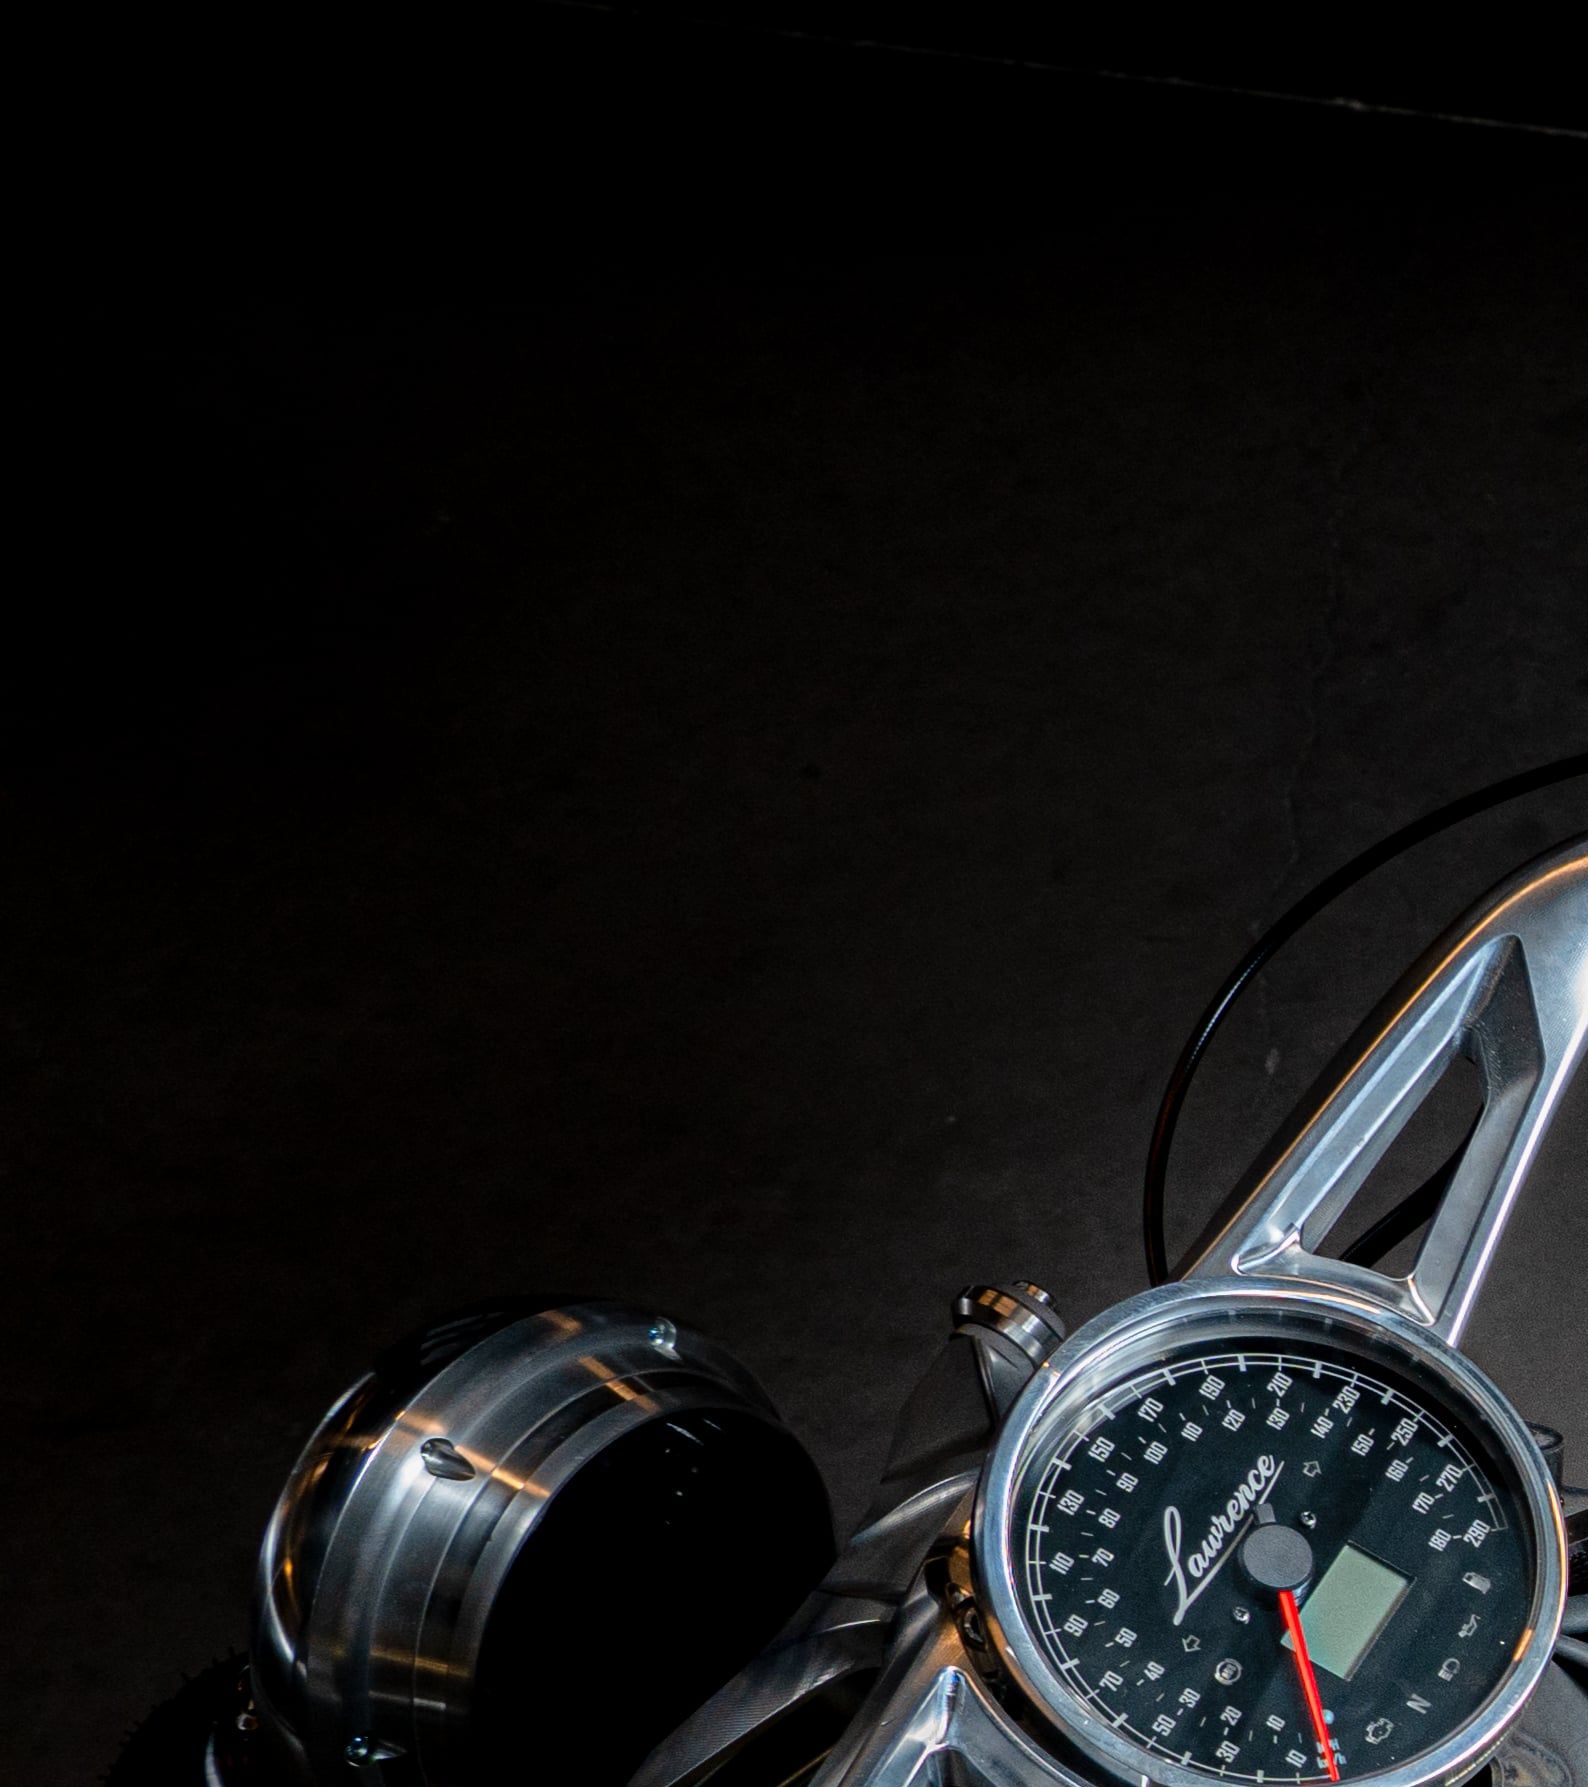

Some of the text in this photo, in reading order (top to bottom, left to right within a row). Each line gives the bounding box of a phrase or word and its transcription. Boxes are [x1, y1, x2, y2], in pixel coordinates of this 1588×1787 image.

[1199, 1375, 1226, 1400] 190
[1266, 1372, 1293, 1397] 210
[1137, 1397, 1164, 1422] 170
[1333, 1385, 1361, 1414] 230
[1222, 1409, 1246, 1432] 120
[1266, 1407, 1290, 1430] 130
[1310, 1416, 1334, 1439] 140
[1181, 1421, 1203, 1442] 110
[1391, 1417, 1419, 1447] 250
[1088, 1436, 1116, 1463] 150
[1143, 1441, 1168, 1464] 100
[1351, 1433, 1375, 1457] 150
[1385, 1459, 1409, 1482] 160
[1436, 1464, 1464, 1492] 270
[1116, 1472, 1139, 1493] 90
[1057, 1489, 1085, 1515] 130
[1412, 1491, 1436, 1515] 170
[1098, 1508, 1121, 1529] 80
[1163, 1454, 1284, 1626] Lawrence
[1428, 1528, 1452, 1552] 180
[1463, 1519, 1492, 1548] 290
[1049, 1551, 1075, 1575] 110
[1091, 1547, 1115, 1567] 70
[1097, 1588, 1121, 1609] 60
[1063, 1613, 1089, 1637] 90
[1115, 1627, 1138, 1648] 50
[1099, 1670, 1124, 1692] 70
[1144, 1661, 1165, 1682] 40
[1179, 1687, 1201, 1709] 30
[1406, 1693, 1432, 1714] N
[1152, 1714, 1177, 1737] 50
[1221, 1705, 1242, 1727] 20
[1266, 1714, 1286, 1732] 10
[1215, 1740, 1241, 1763] 30
[1285, 1749, 1307, 1768] 10
